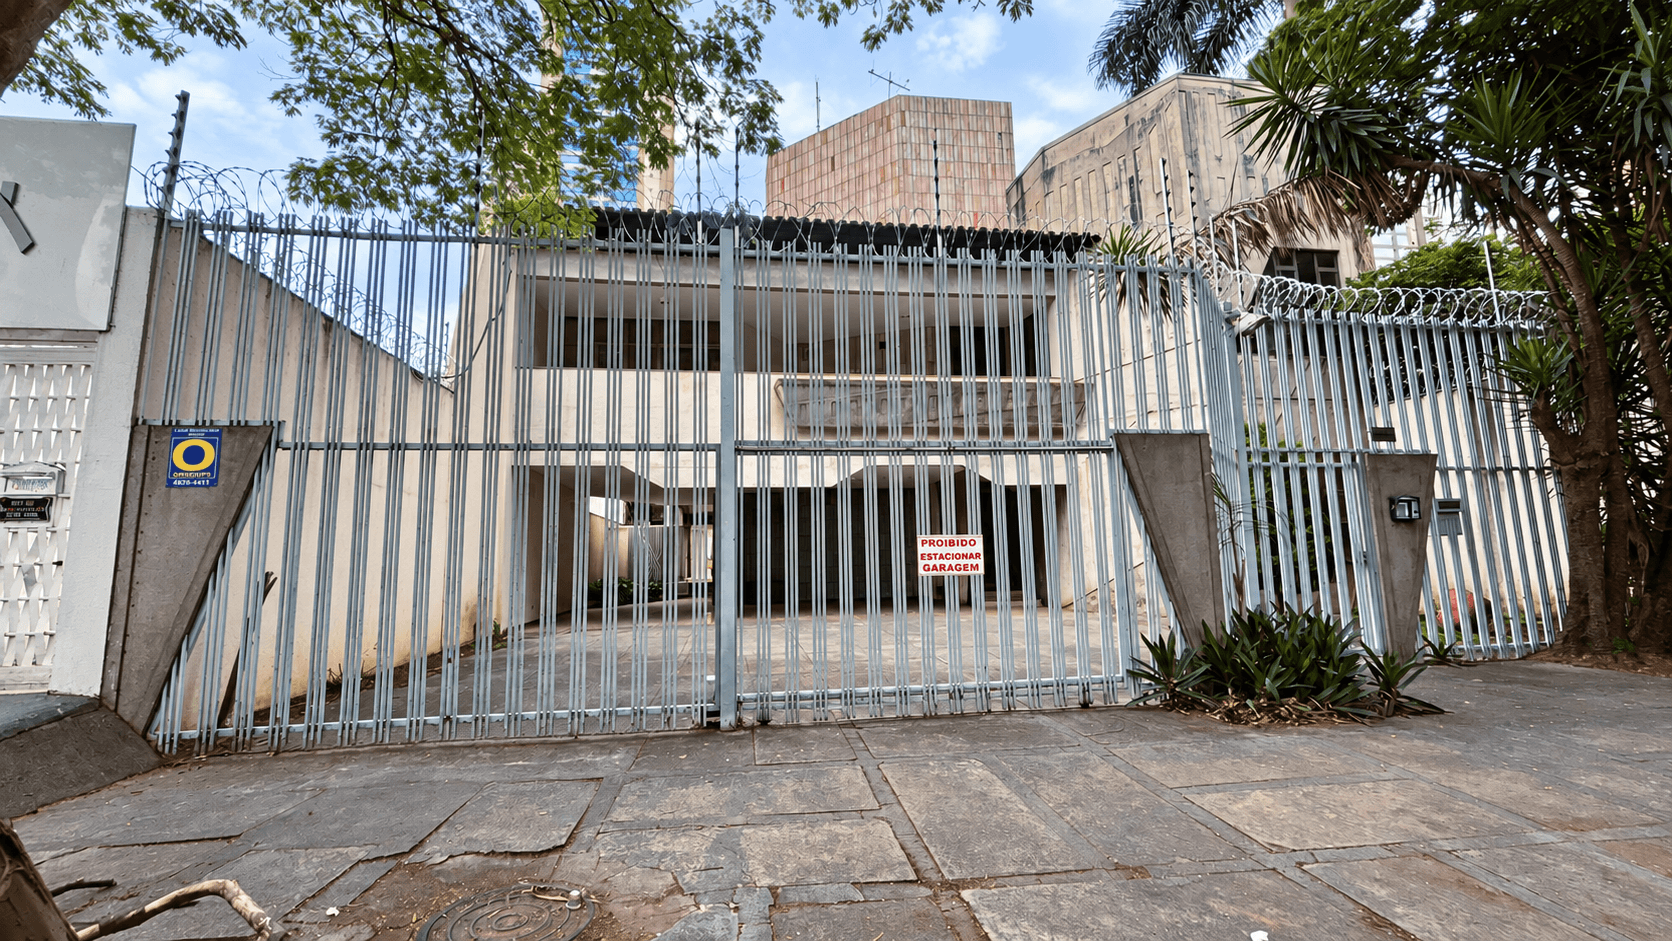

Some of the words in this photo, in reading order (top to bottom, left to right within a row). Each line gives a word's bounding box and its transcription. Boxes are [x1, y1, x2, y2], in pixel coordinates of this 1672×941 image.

[921, 538, 977, 547] PROIBIDO
[920, 552, 982, 561] ESTACIONAR
[922, 563, 980, 572] GARAGEM
